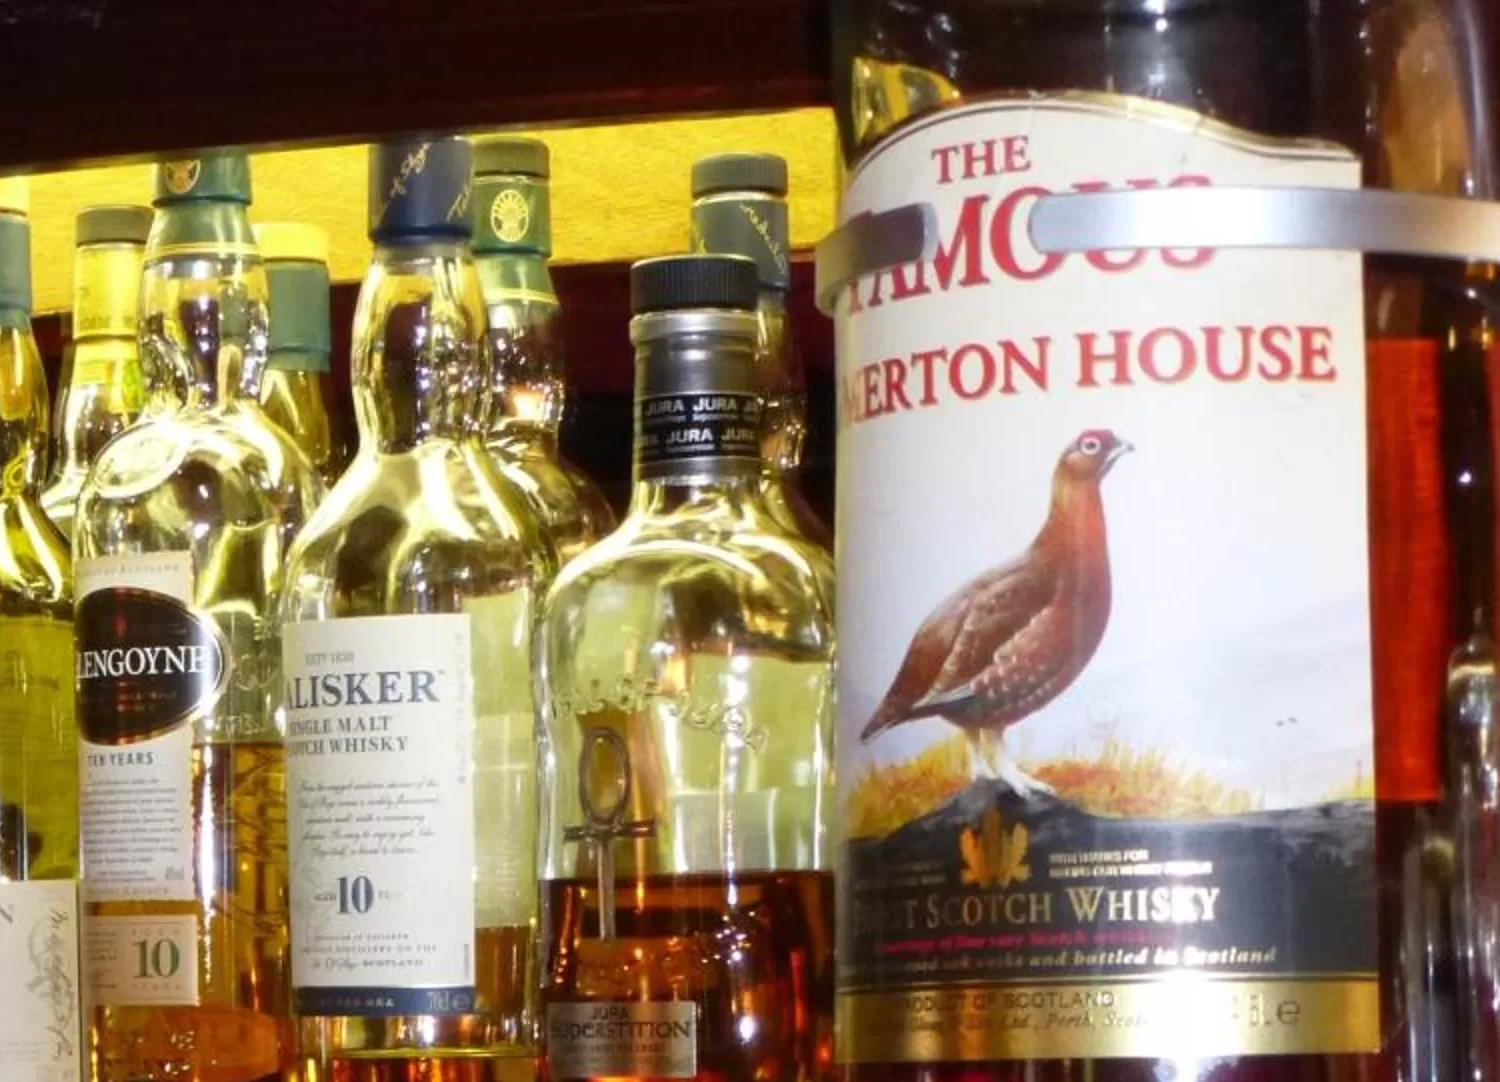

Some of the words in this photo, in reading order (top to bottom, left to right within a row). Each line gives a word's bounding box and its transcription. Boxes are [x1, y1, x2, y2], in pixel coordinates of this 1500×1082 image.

[931, 135, 1032, 184] THE
[1075, 325, 1338, 387] HOUSE
[692, 396, 738, 412] JURA
[665, 427, 714, 444] JURA
[338, 714, 392, 733] MALT
[329, 736, 409, 754] WHISKY
[109, 752, 155, 766] YEARS
[336, 875, 374, 915] 10
[924, 891, 1052, 929] SCOTCH
[1065, 884, 1221, 924] WHISKY
[132, 938, 181, 979] 10
[1073, 947, 1149, 966] bottled
[1183, 946, 1278, 966] Scotland
[1008, 991, 1115, 1011] SCOTLAND
